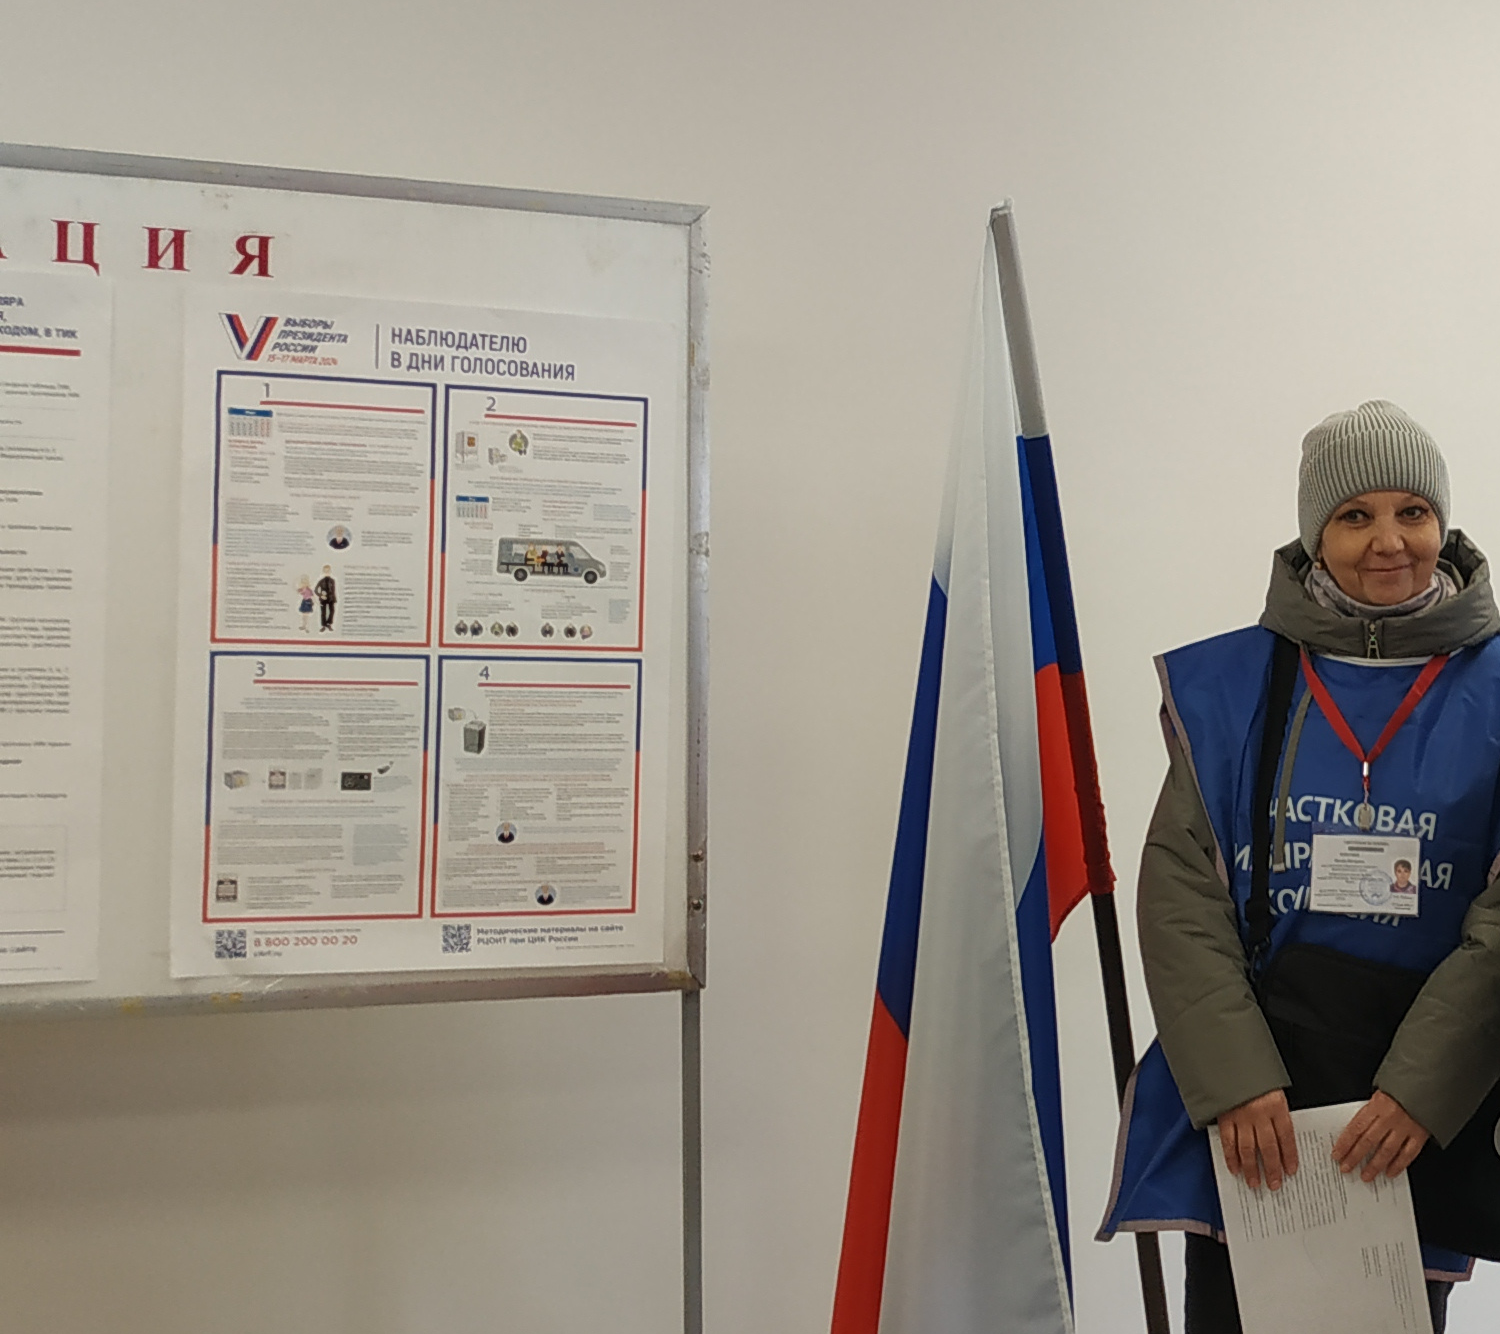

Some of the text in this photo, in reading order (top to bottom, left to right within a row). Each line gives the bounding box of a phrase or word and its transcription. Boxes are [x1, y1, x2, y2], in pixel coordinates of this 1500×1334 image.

[0, 219, 275, 278] ЦИЯ
[283, 317, 335, 330] ВЫБОРЫ
[277, 329, 349, 344] ПРЕЗИДЕНТА
[391, 327, 528, 354] НАБЛЮДАТЕЛЮ
[271, 342, 319, 354] РОССИИ
[390, 351, 576, 381] В ДНИ ГОЛОСОВАНИЯ
[263, 382, 271, 398] 1
[486, 396, 497, 412] 2
[255, 661, 265, 677] 3
[479, 665, 490, 681] 4
[293, 935, 318, 947] 200
[321, 935, 339, 946] 00
[342, 934, 358, 946] 20
